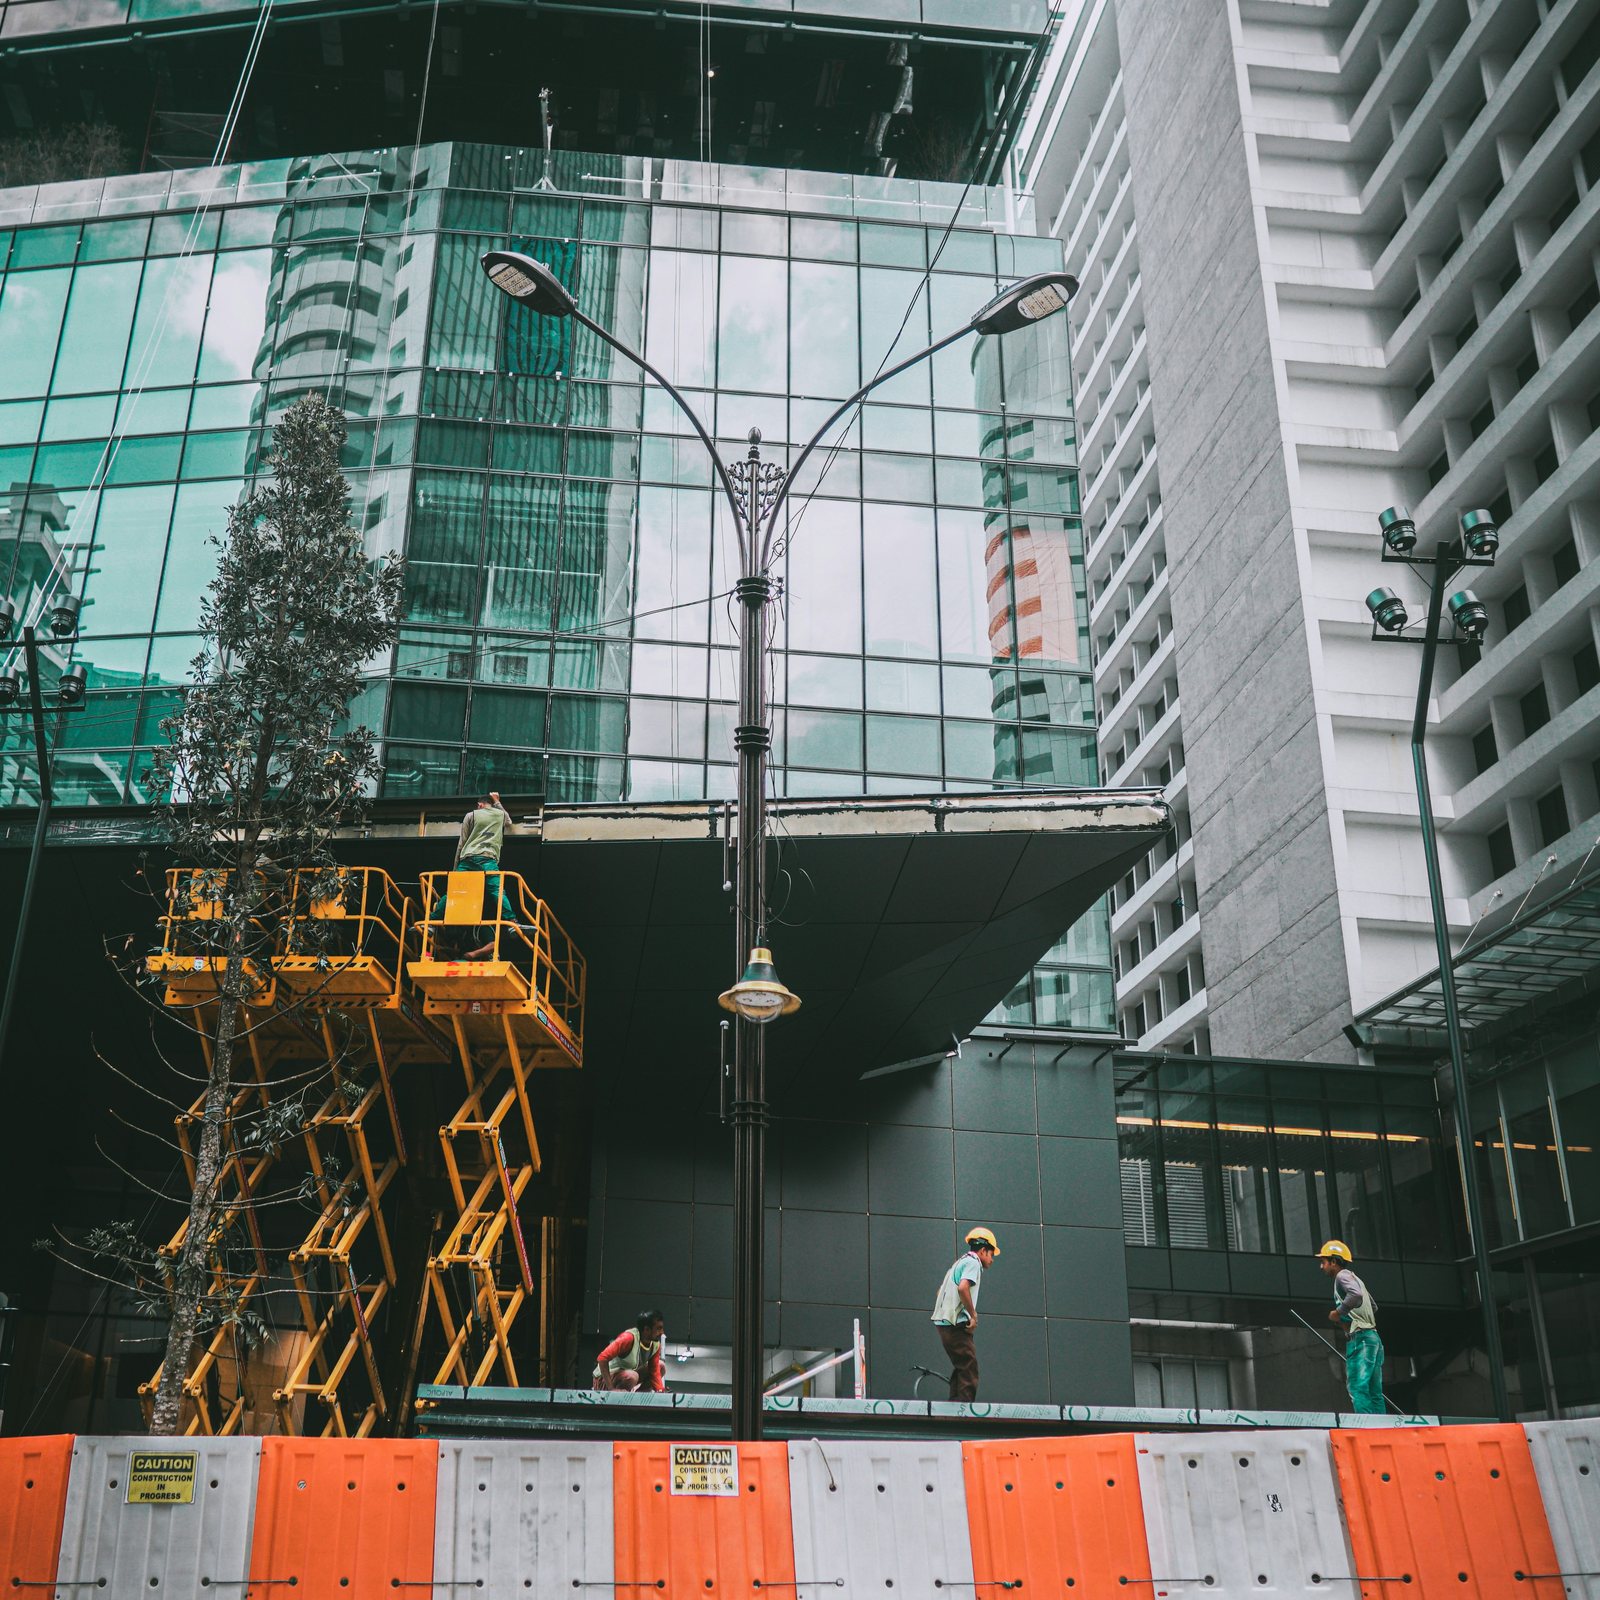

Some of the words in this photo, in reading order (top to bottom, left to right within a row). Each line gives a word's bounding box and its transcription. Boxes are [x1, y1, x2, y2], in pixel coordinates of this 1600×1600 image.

[675, 1450, 731, 1463] CAUTION
[135, 1459, 192, 1469] CAUTION
[132, 1474, 192, 1482] CONSTRUCTION
[140, 1492, 181, 1500] PROGRESS
